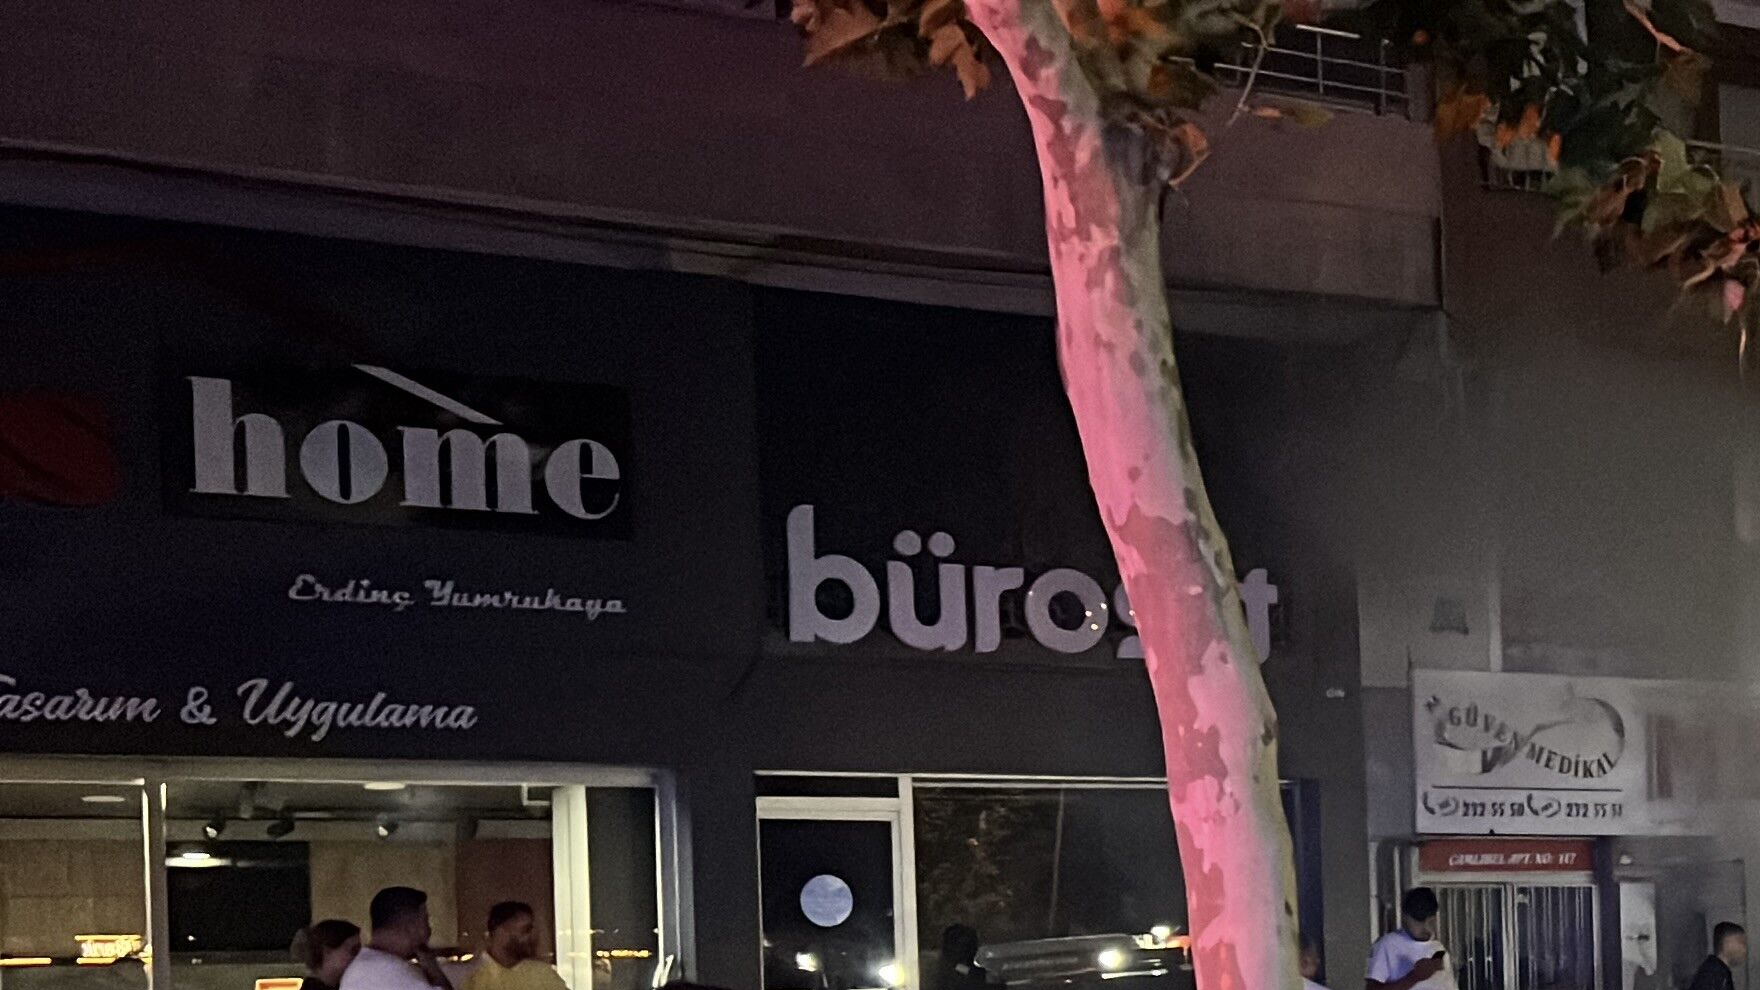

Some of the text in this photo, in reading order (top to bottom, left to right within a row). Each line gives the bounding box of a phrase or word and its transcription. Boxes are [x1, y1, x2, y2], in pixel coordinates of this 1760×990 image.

[183, 374, 622, 520] home
[288, 574, 414, 611] Erdinç
[787, 503, 1278, 665] bürot
[180, 687, 216, 724] &
[237, 678, 478, 742] Uygulama
